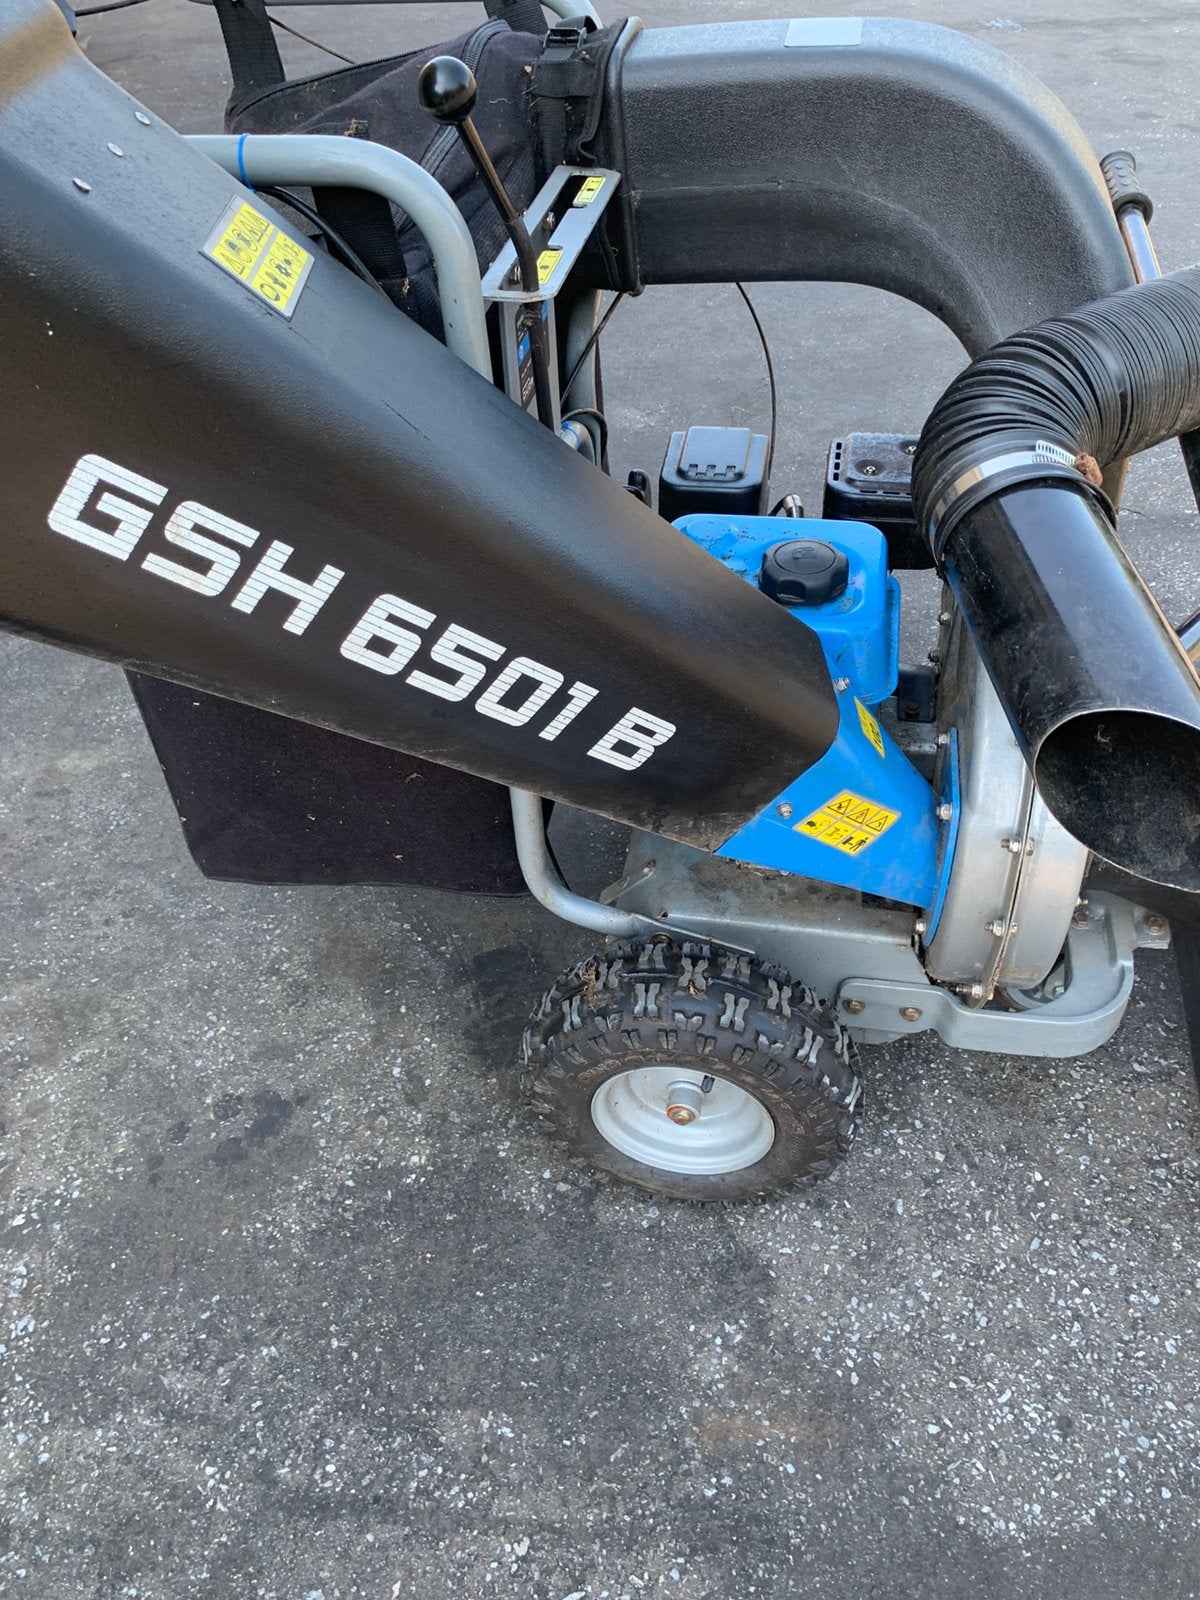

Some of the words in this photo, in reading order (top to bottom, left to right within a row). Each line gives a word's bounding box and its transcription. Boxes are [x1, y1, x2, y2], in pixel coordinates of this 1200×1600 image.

[48, 454, 345, 635] GSH
[340, 594, 599, 741] 6501
[587, 707, 676, 770] B
